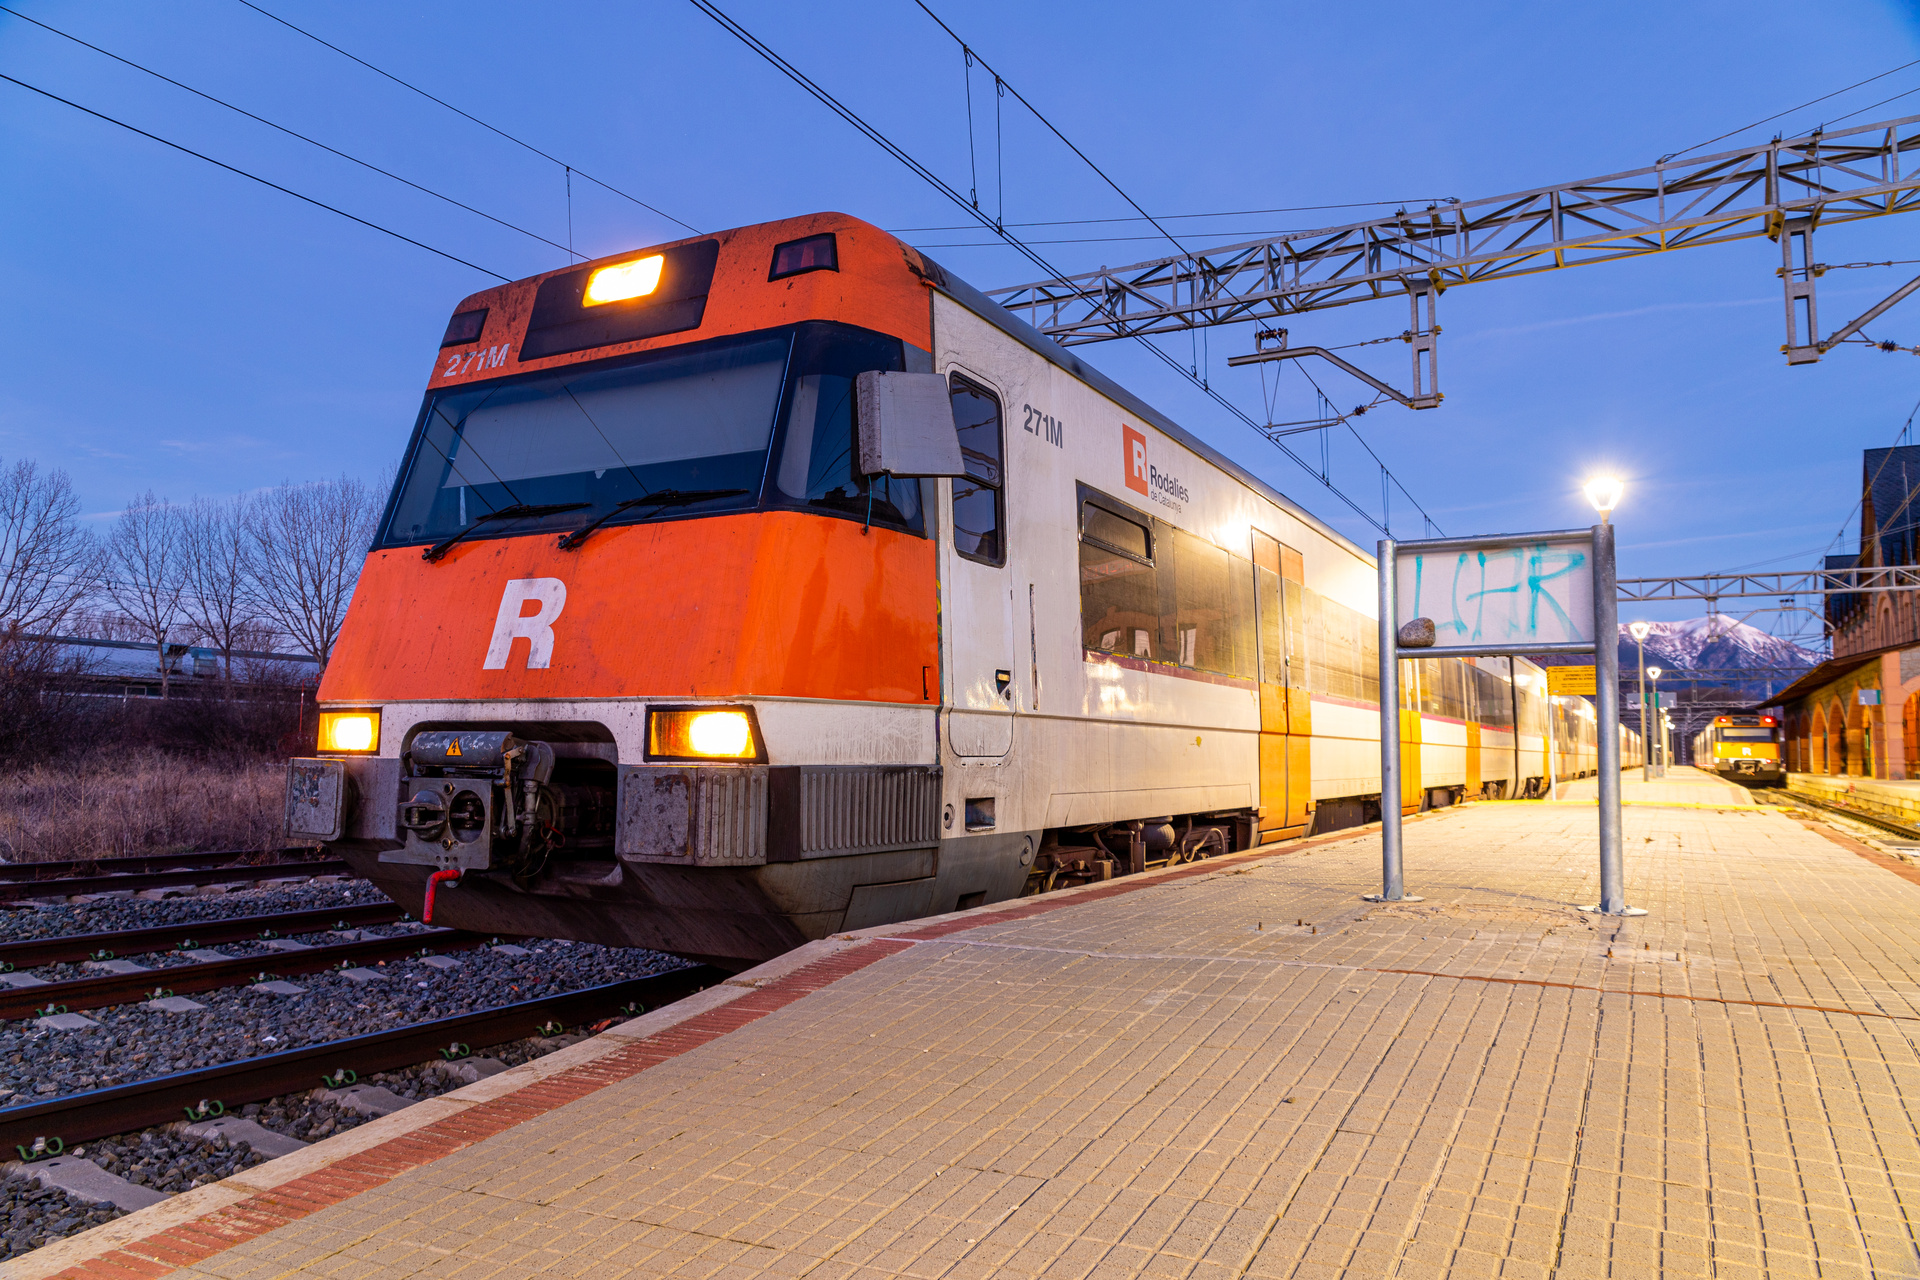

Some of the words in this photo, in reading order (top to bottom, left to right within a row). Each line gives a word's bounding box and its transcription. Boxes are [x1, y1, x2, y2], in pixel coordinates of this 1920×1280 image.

[443, 343, 510, 377] 271M
[1023, 403, 1063, 449] 271M
[1132, 439, 1147, 482] R
[1150, 464, 1189, 503] Rodalies
[1150, 489, 1158, 502] de
[1158, 492, 1182, 514] Catalunya
[482, 577, 567, 670] R
[1669, 699, 1676, 708] 1
[1741, 747, 1752, 756] R
